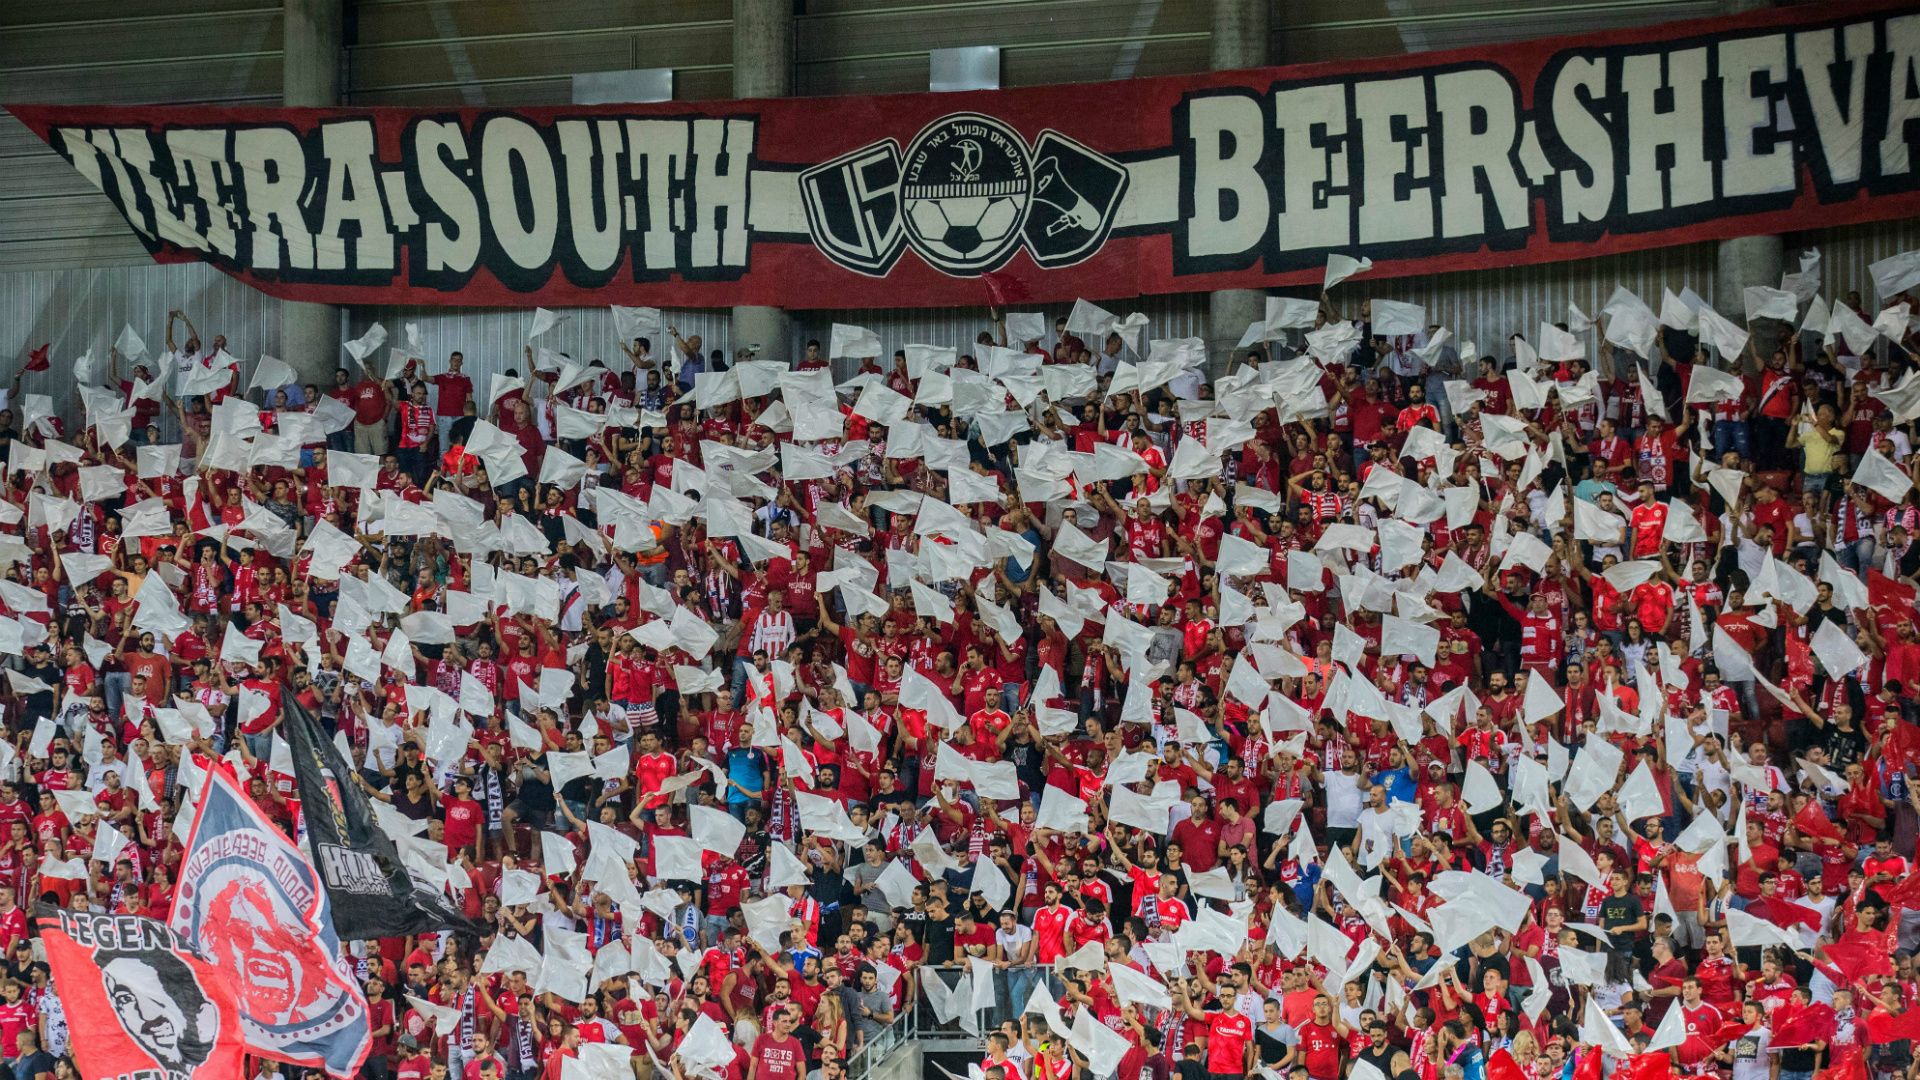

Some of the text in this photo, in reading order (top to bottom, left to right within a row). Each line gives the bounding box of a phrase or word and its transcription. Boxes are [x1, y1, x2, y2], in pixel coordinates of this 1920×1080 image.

[927, 131, 950, 149] באר
[952, 124, 988, 138] הפועל
[1189, 14, 1920, 257] BEER SHEVA
[909, 150, 928, 183] שבע
[415, 117, 755, 273] SOUTH
[1607, 907, 1626, 916] EA7
